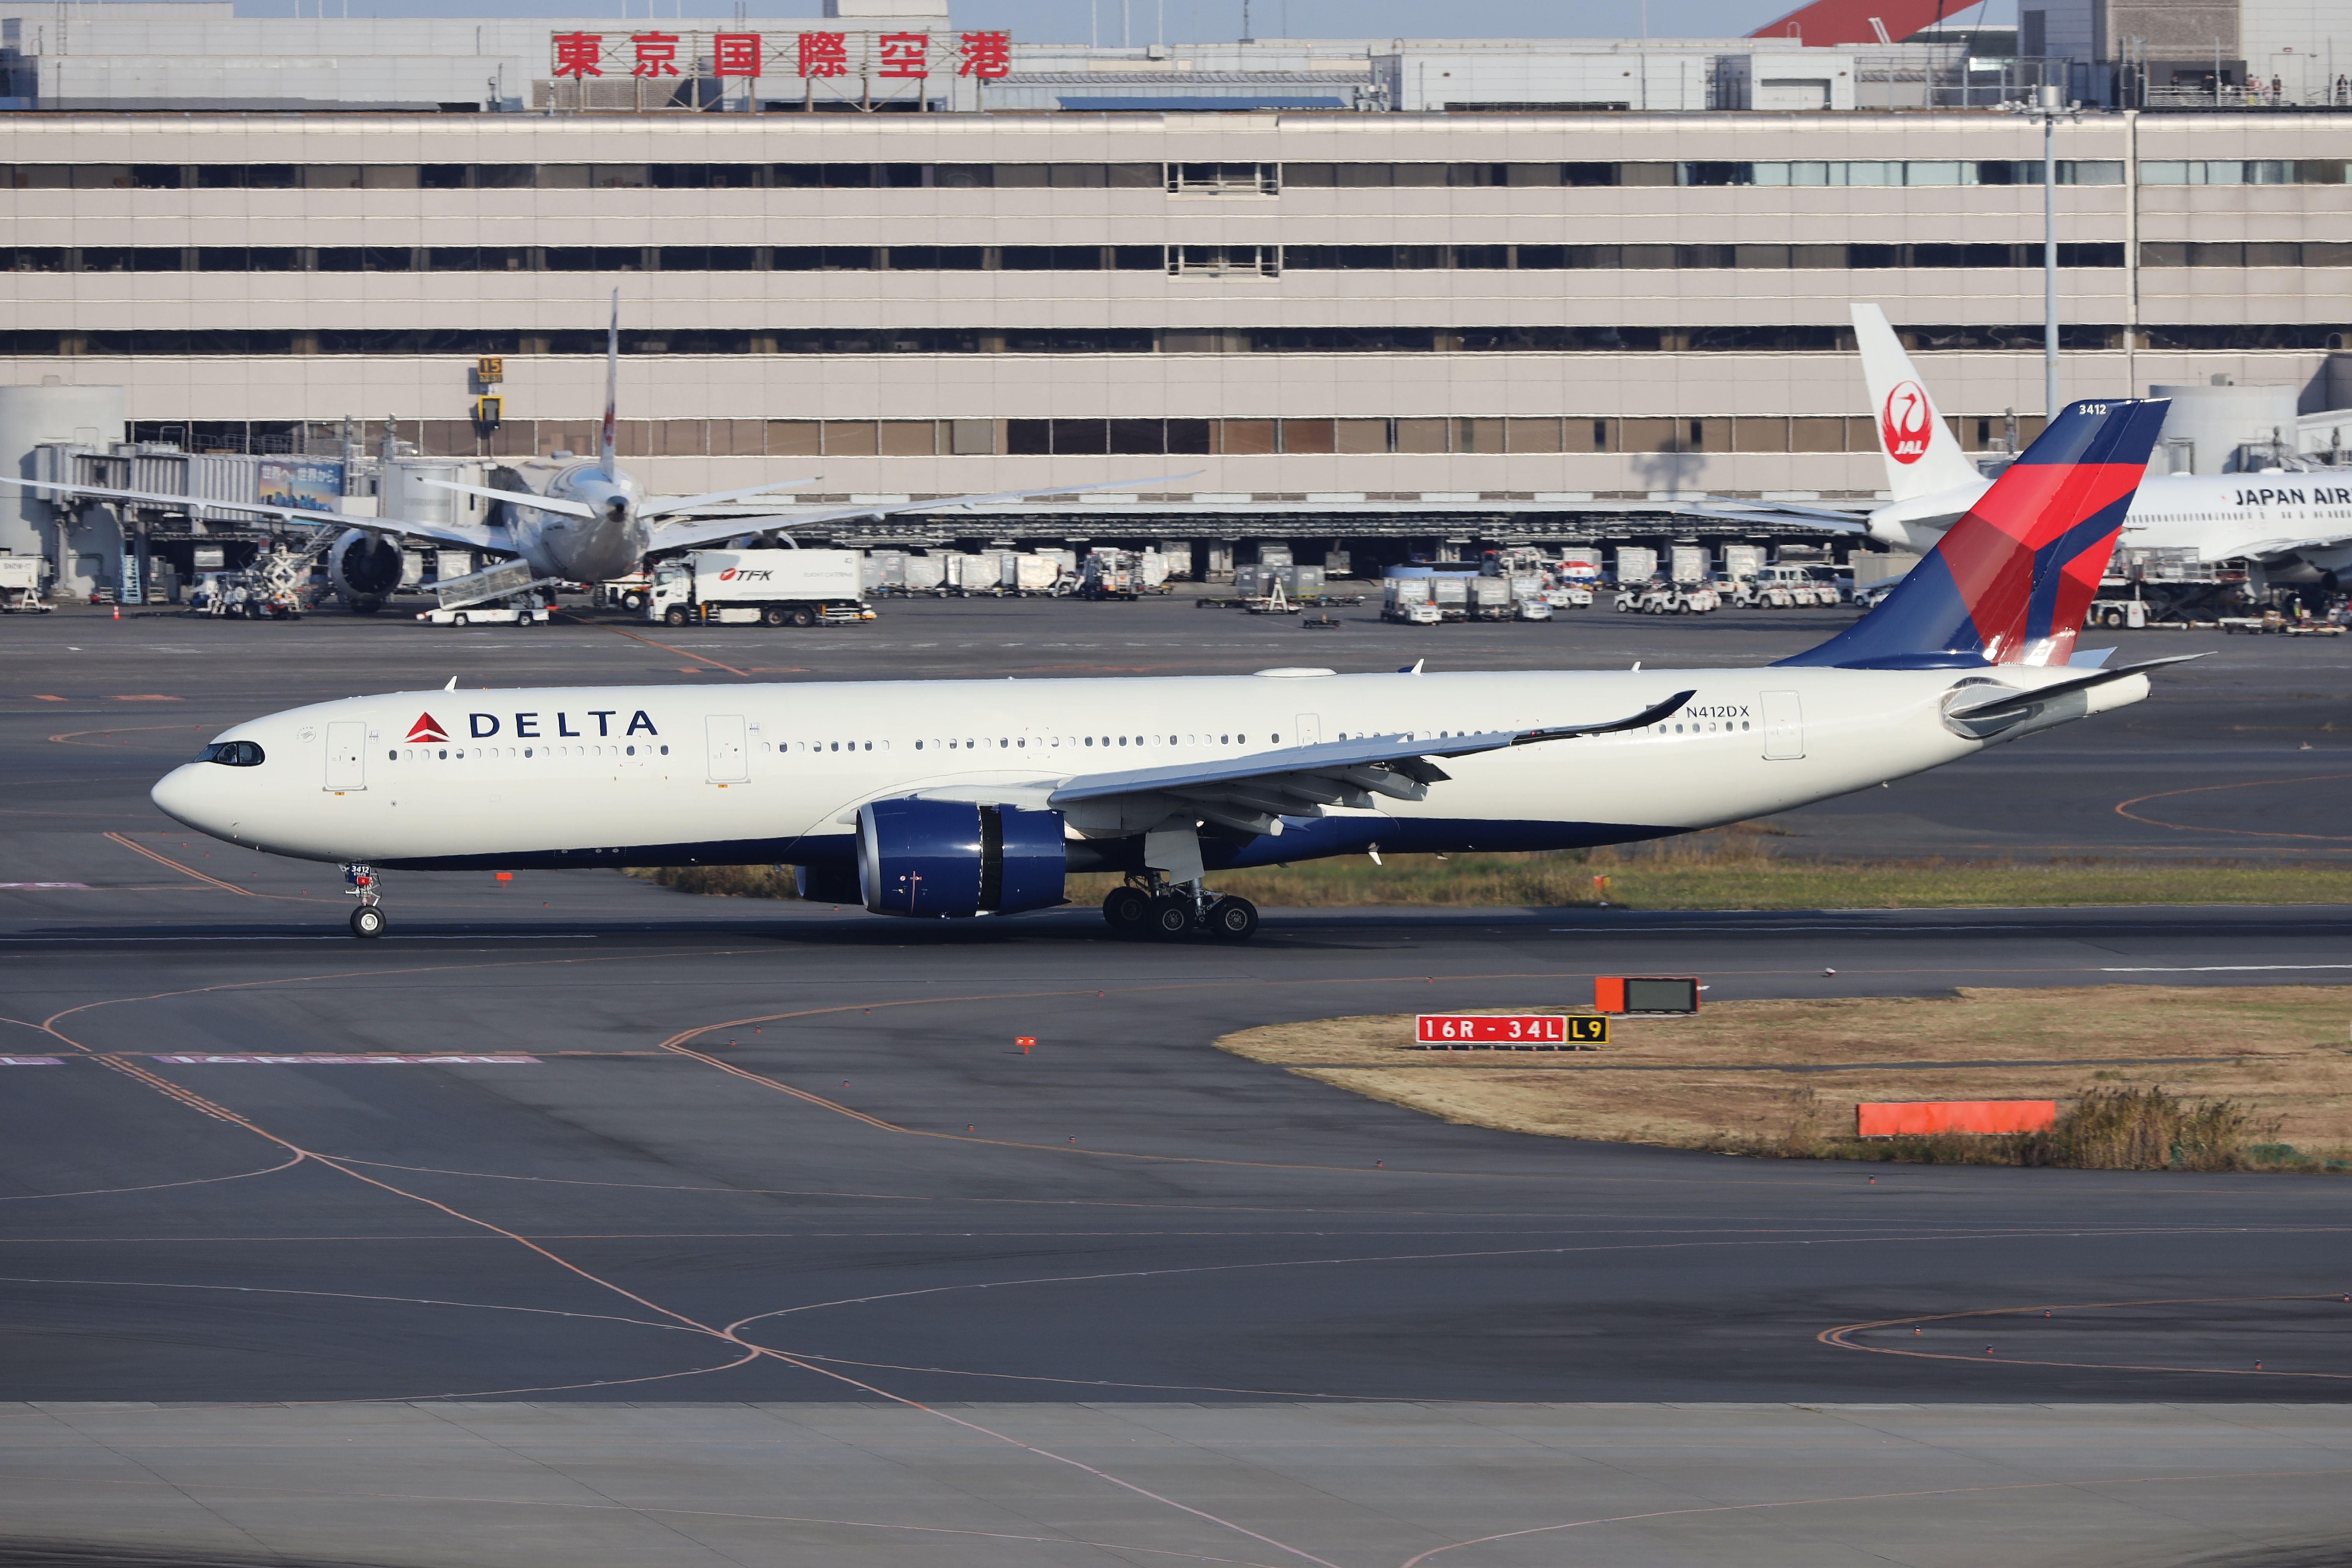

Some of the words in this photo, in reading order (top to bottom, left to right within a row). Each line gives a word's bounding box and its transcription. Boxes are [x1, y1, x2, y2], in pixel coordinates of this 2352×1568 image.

[553, 31, 1010, 78] 東京国際空港
[484, 360, 500, 372] 15
[2079, 404, 2107, 415] 3412
[1894, 440, 1924, 454] JAL
[2236, 488, 2305, 506] JAPAN
[2315, 487, 2352, 504] AIR
[737, 570, 774, 581] TFK
[1686, 705, 1750, 718] N412DX
[469, 710, 658, 738] DELTA
[1425, 1020, 1474, 1038] 16R
[1508, 1020, 1559, 1039] 34L
[1572, 1021, 1602, 1038] L9
